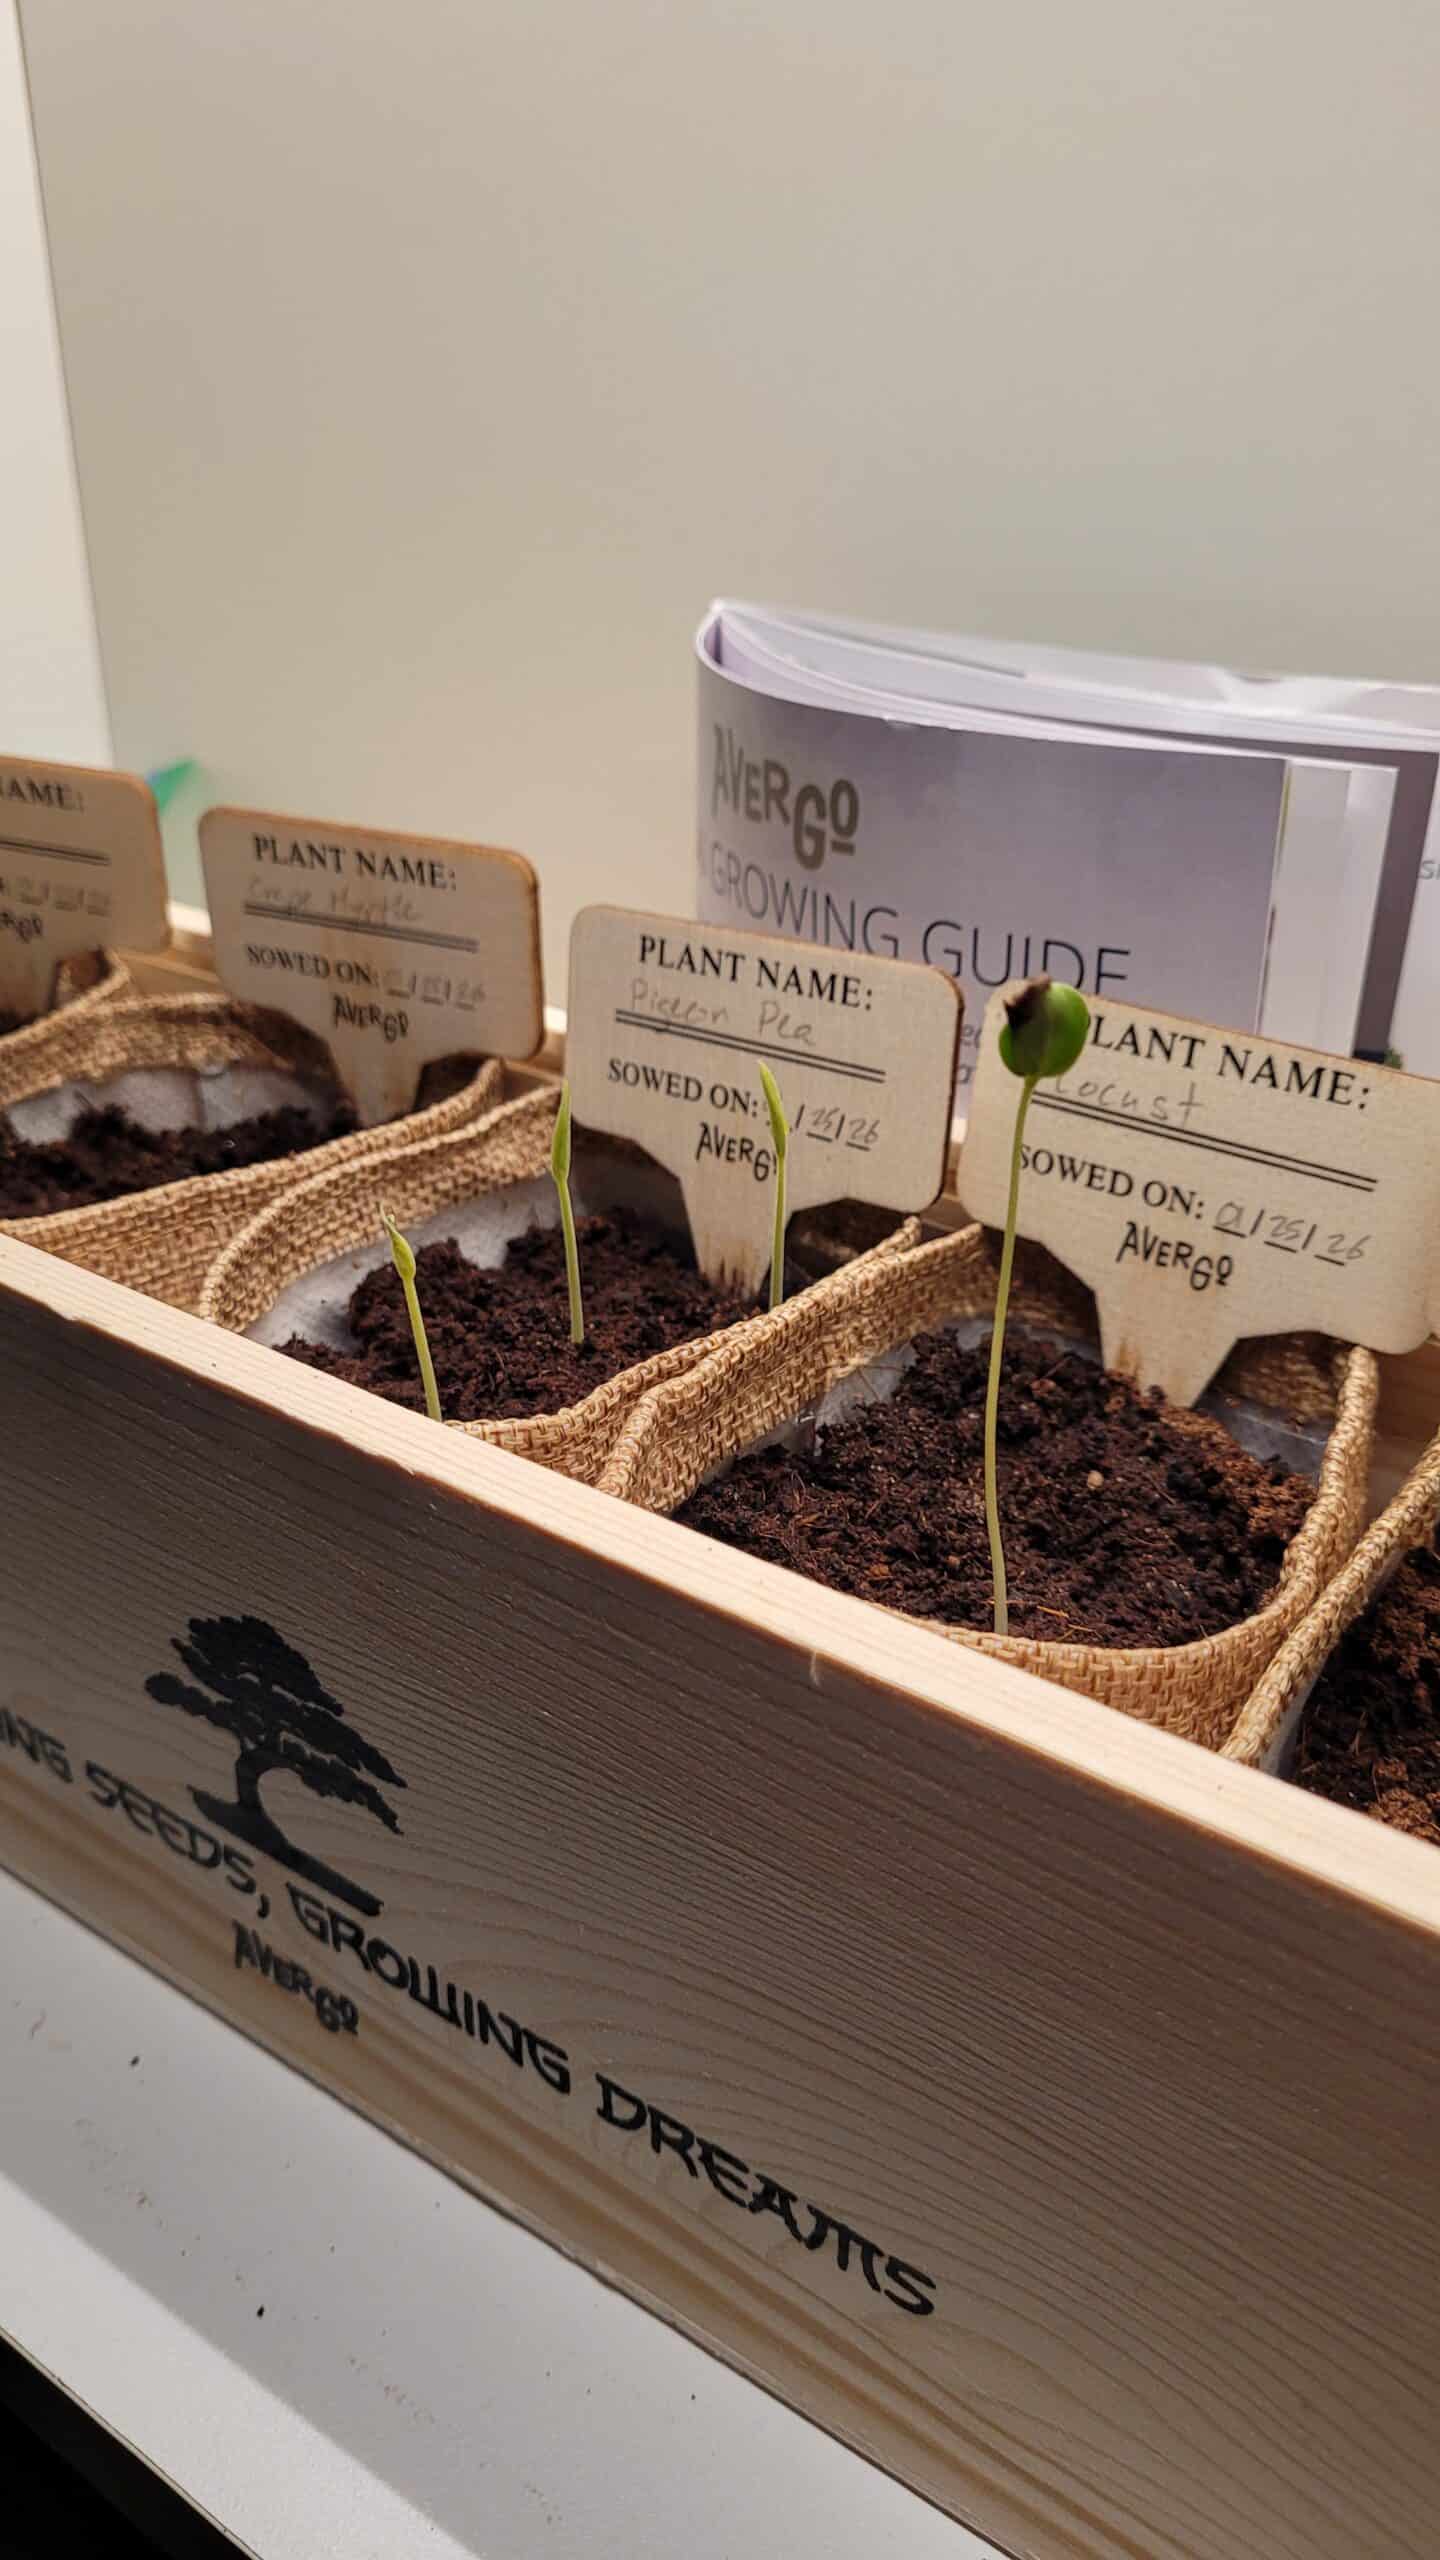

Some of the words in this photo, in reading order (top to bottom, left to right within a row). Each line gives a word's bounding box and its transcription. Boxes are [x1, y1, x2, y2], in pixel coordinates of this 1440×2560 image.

[711, 722, 860, 871] AVERGO
[253, 834, 347, 874] PLANT
[356, 850, 457, 890] NAME:
[711, 841, 899, 960] GROWING
[922, 920, 1131, 995] GUIDE
[246, 945, 330, 980] SOWED
[335, 960, 380, 988] ON:
[639, 934, 746, 983] PLANT
[757, 957, 873, 1012] NAME:
[331, 992, 409, 1043] AVERGO
[759, 1000, 815, 1046] Pea
[608, 1057, 702, 1102] SOWED
[709, 1083, 758, 1119] ON:
[1089, 1015, 1207, 1069] LANT
[1217, 1044, 1373, 1111] NAME:
[1020, 1144, 1133, 1198] SOWED
[1143, 1179, 1204, 1220] ON:
[1115, 1220, 1233, 1290] AVERGO
[0, 1707, 73, 1783] ING
[85, 1760, 270, 1919] SEEDS,
[286, 1881, 571, 2095] GROWING
[595, 2072, 937, 2317] DREAMS
[231, 1918, 360, 2036] AVERGO
